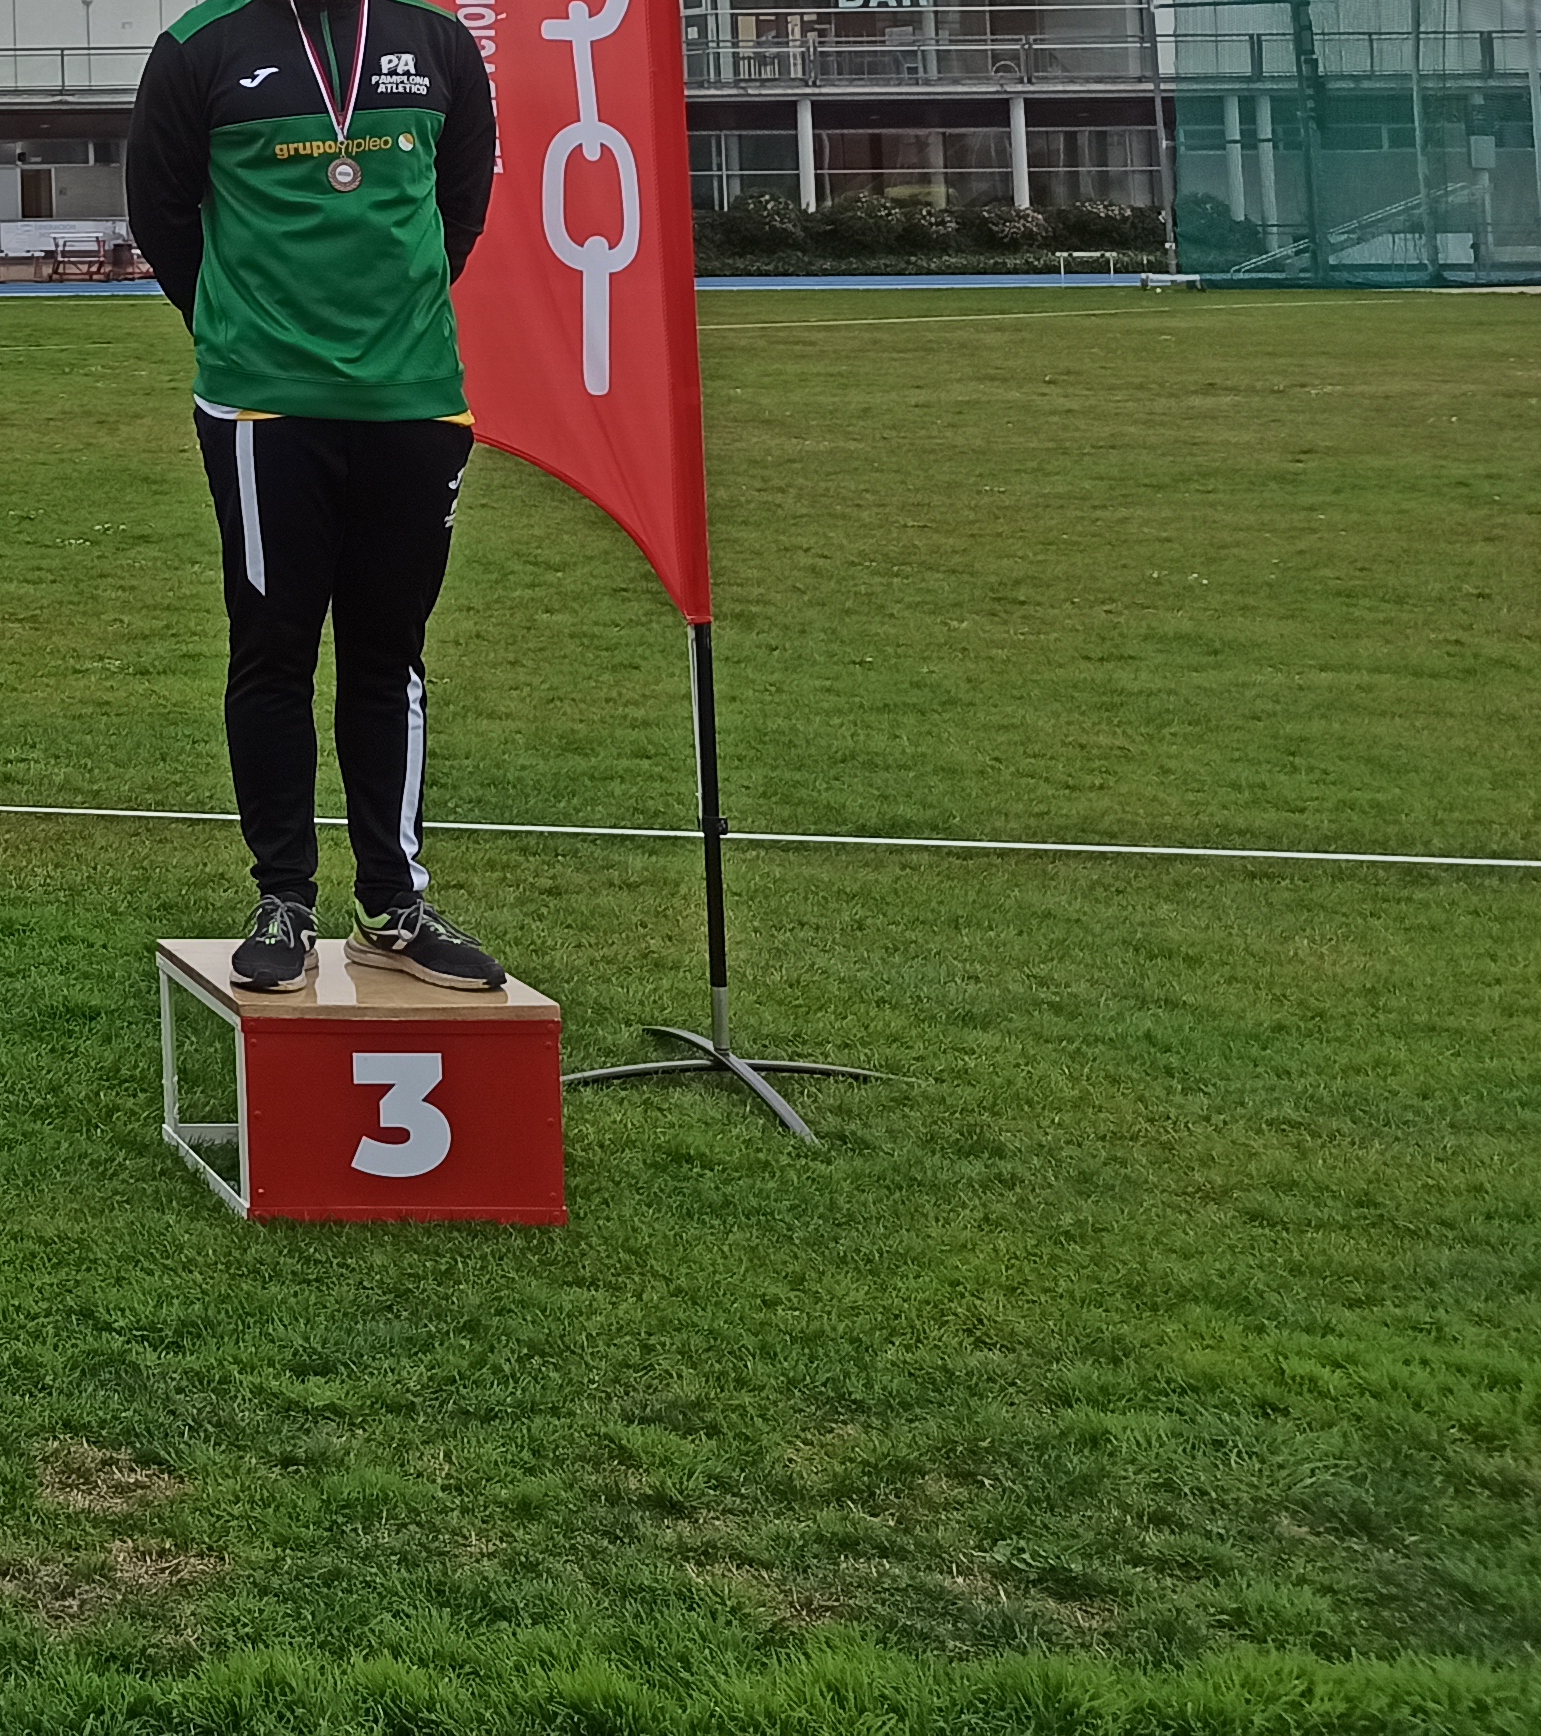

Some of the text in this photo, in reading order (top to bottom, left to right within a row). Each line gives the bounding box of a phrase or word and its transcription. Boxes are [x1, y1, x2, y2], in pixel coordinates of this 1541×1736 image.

[380, 53, 416, 74] PA
[371, 75, 430, 87] PAMPLONA
[351, 1052, 452, 1178] 3
